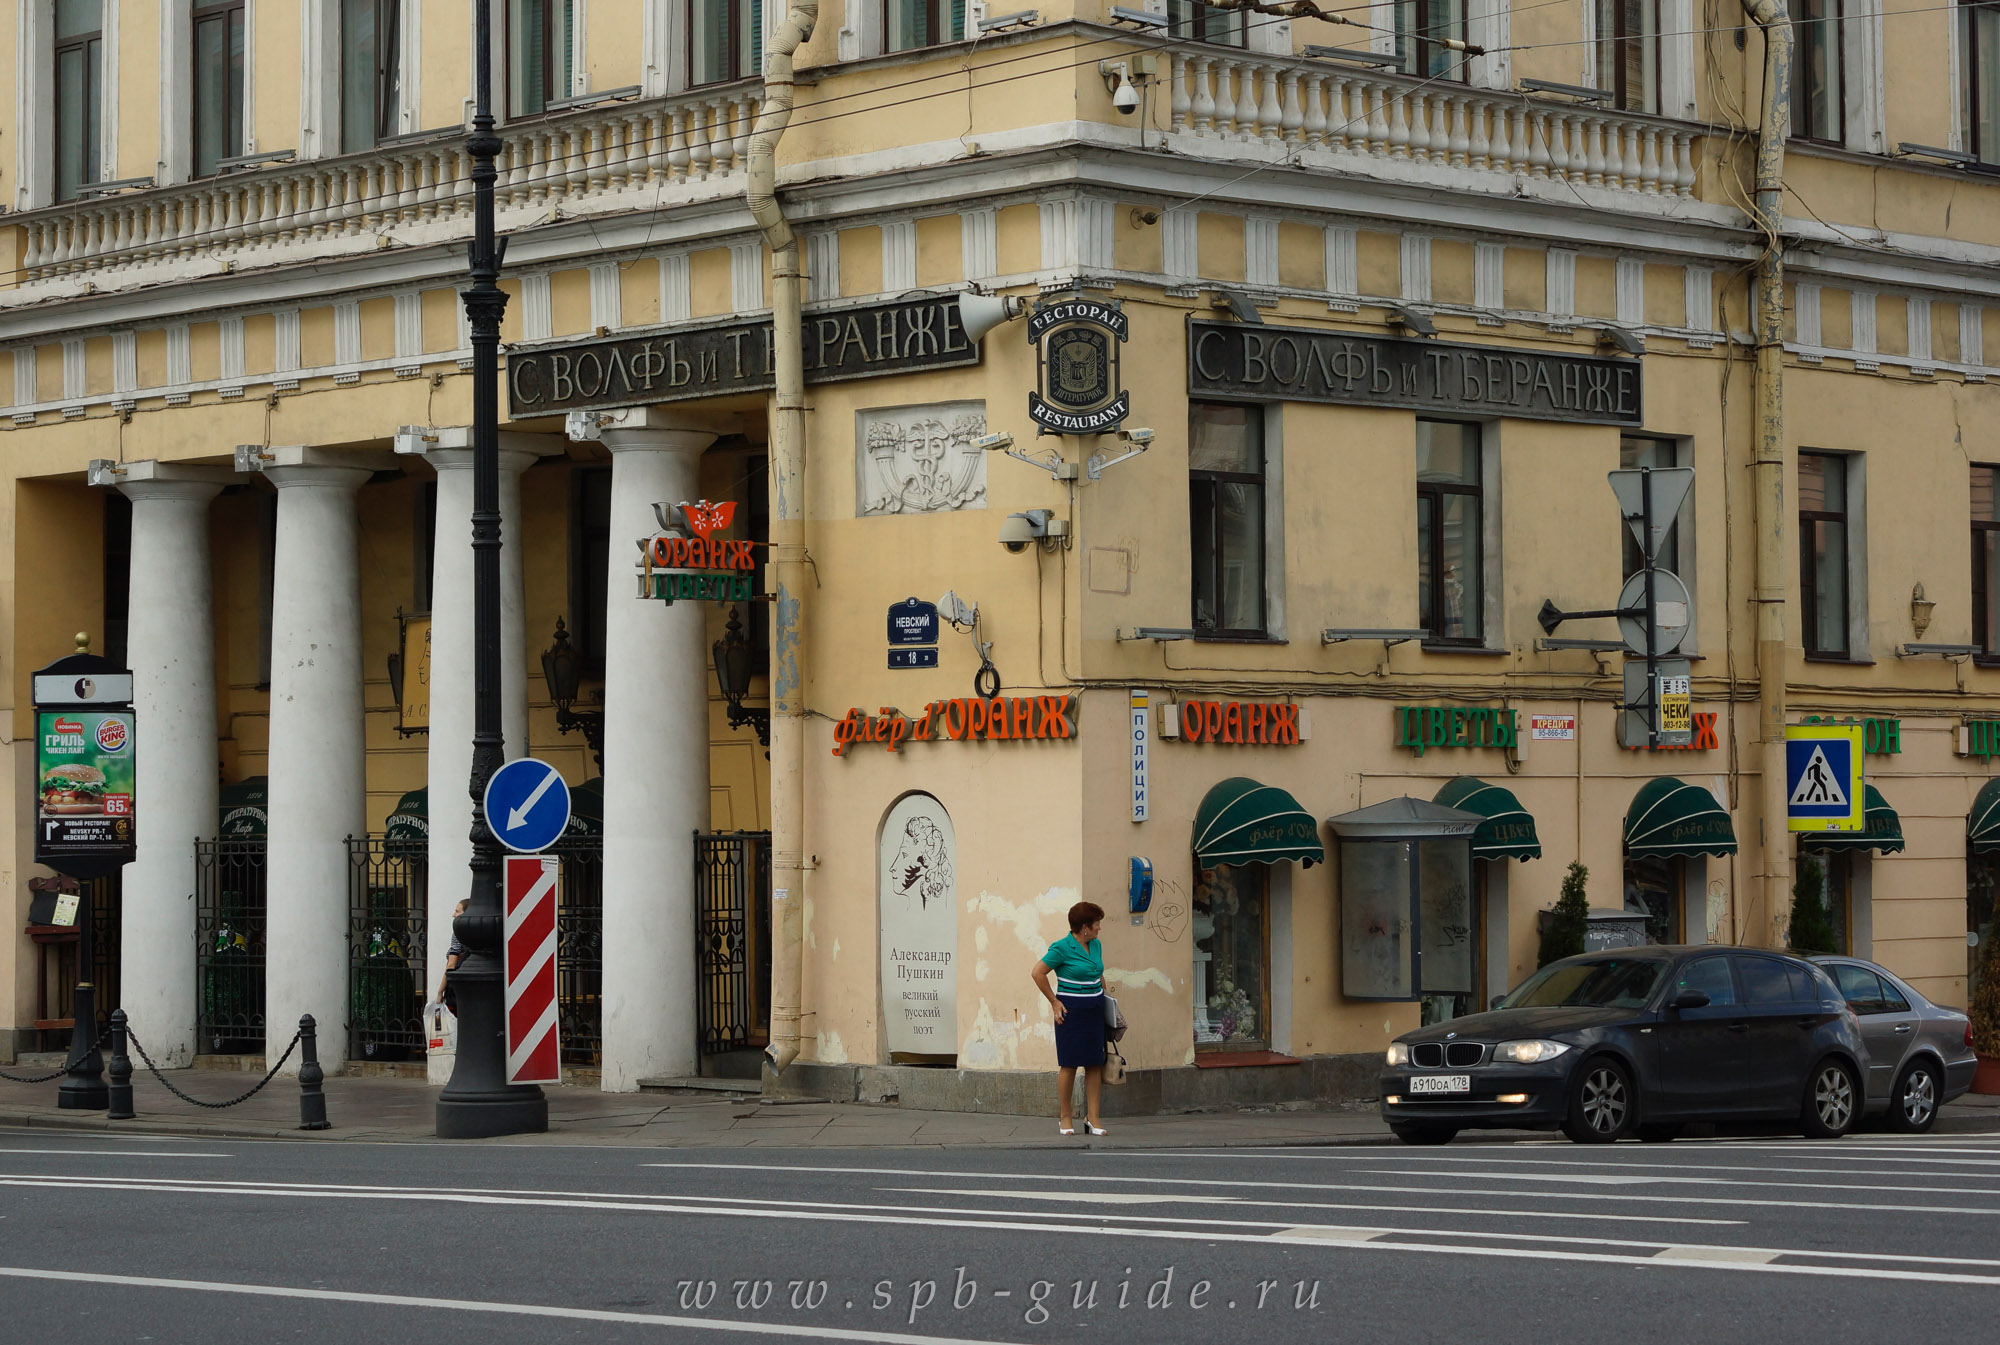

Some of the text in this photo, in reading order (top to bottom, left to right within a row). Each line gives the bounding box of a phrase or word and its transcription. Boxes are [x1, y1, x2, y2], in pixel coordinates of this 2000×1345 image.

[1033, 305, 1123, 330] РЕСТОРАН
[513, 358, 545, 404] С.
[701, 350, 719, 384] и
[762, 302, 968, 375] БРАНЖЕ
[1195, 330, 1231, 381] С.
[1401, 362, 1419, 396] и
[1459, 352, 1637, 415] БЕРАНЖЕ
[1033, 400, 1127, 428] RESTAURANT
[654, 537, 755, 570] ОРАНЖ
[655, 573, 754, 606] ЦВЕТЫ
[896, 614, 929, 627] НЕВСКИЙ
[908, 652, 917, 664] 18
[1663, 704, 1689, 718] ЧЕКИ
[99, 725, 124, 736] BURGER
[1183, 701, 1299, 744] ОРАНЖ
[1537, 720, 1569, 728] КРЕДИТ
[100, 731, 125, 744] KING
[832, 706, 906, 757] флёр
[1401, 706, 1518, 757] ЦВЕТЫ
[46, 735, 85, 746] ГРИЛЬ
[1134, 715, 1145, 816] ПОЛИЦИЯ
[231, 820, 254, 836] Кафе
[890, 947, 951, 965] Александр
[897, 965, 943, 981] Пушкин
[902, 989, 938, 1000] великий
[904, 1006, 940, 1020] русский
[913, 1025, 933, 1034] поэт
[1451, 1077, 1466, 1087] 178
